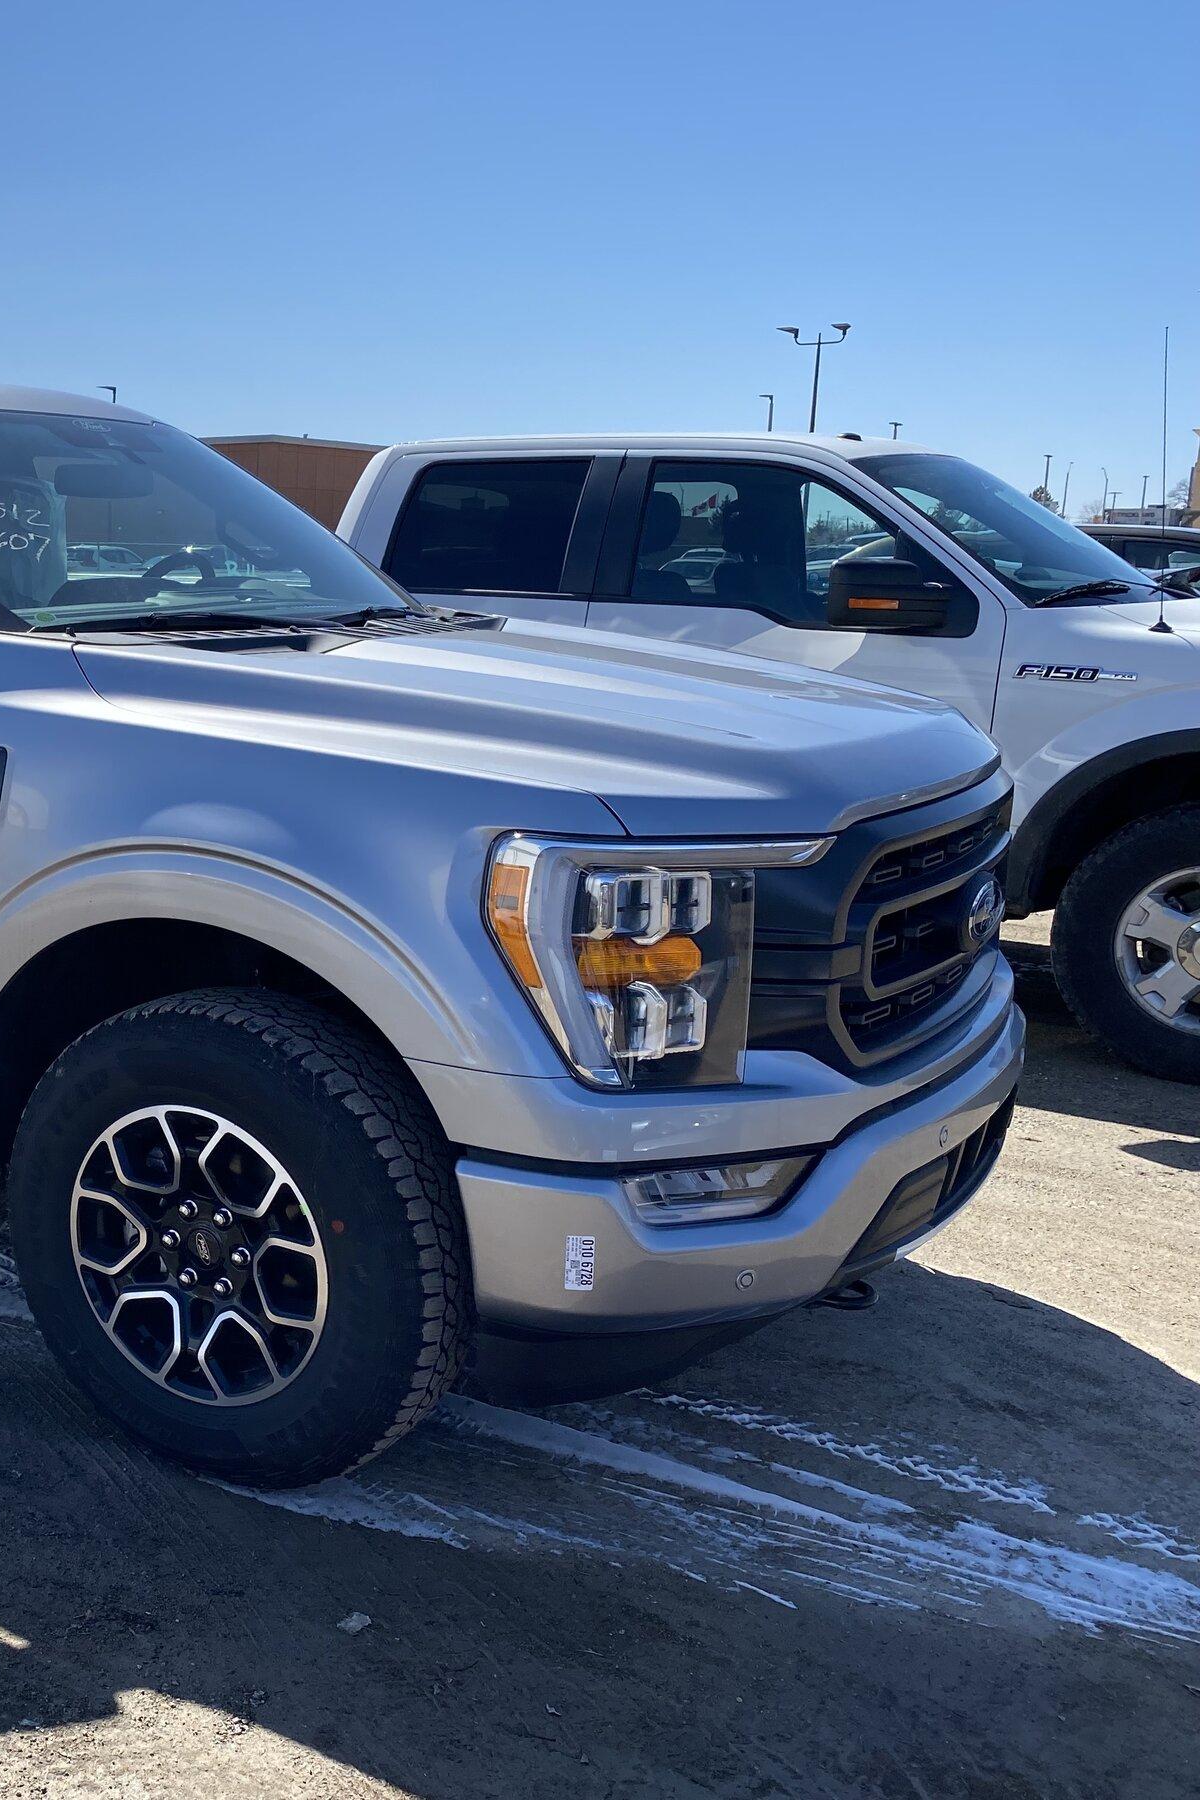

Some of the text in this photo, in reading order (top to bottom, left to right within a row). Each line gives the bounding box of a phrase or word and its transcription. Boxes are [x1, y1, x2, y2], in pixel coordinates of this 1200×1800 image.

[1015, 664, 1101, 681] F-150
[581, 1240, 594, 1285] 010 6728
